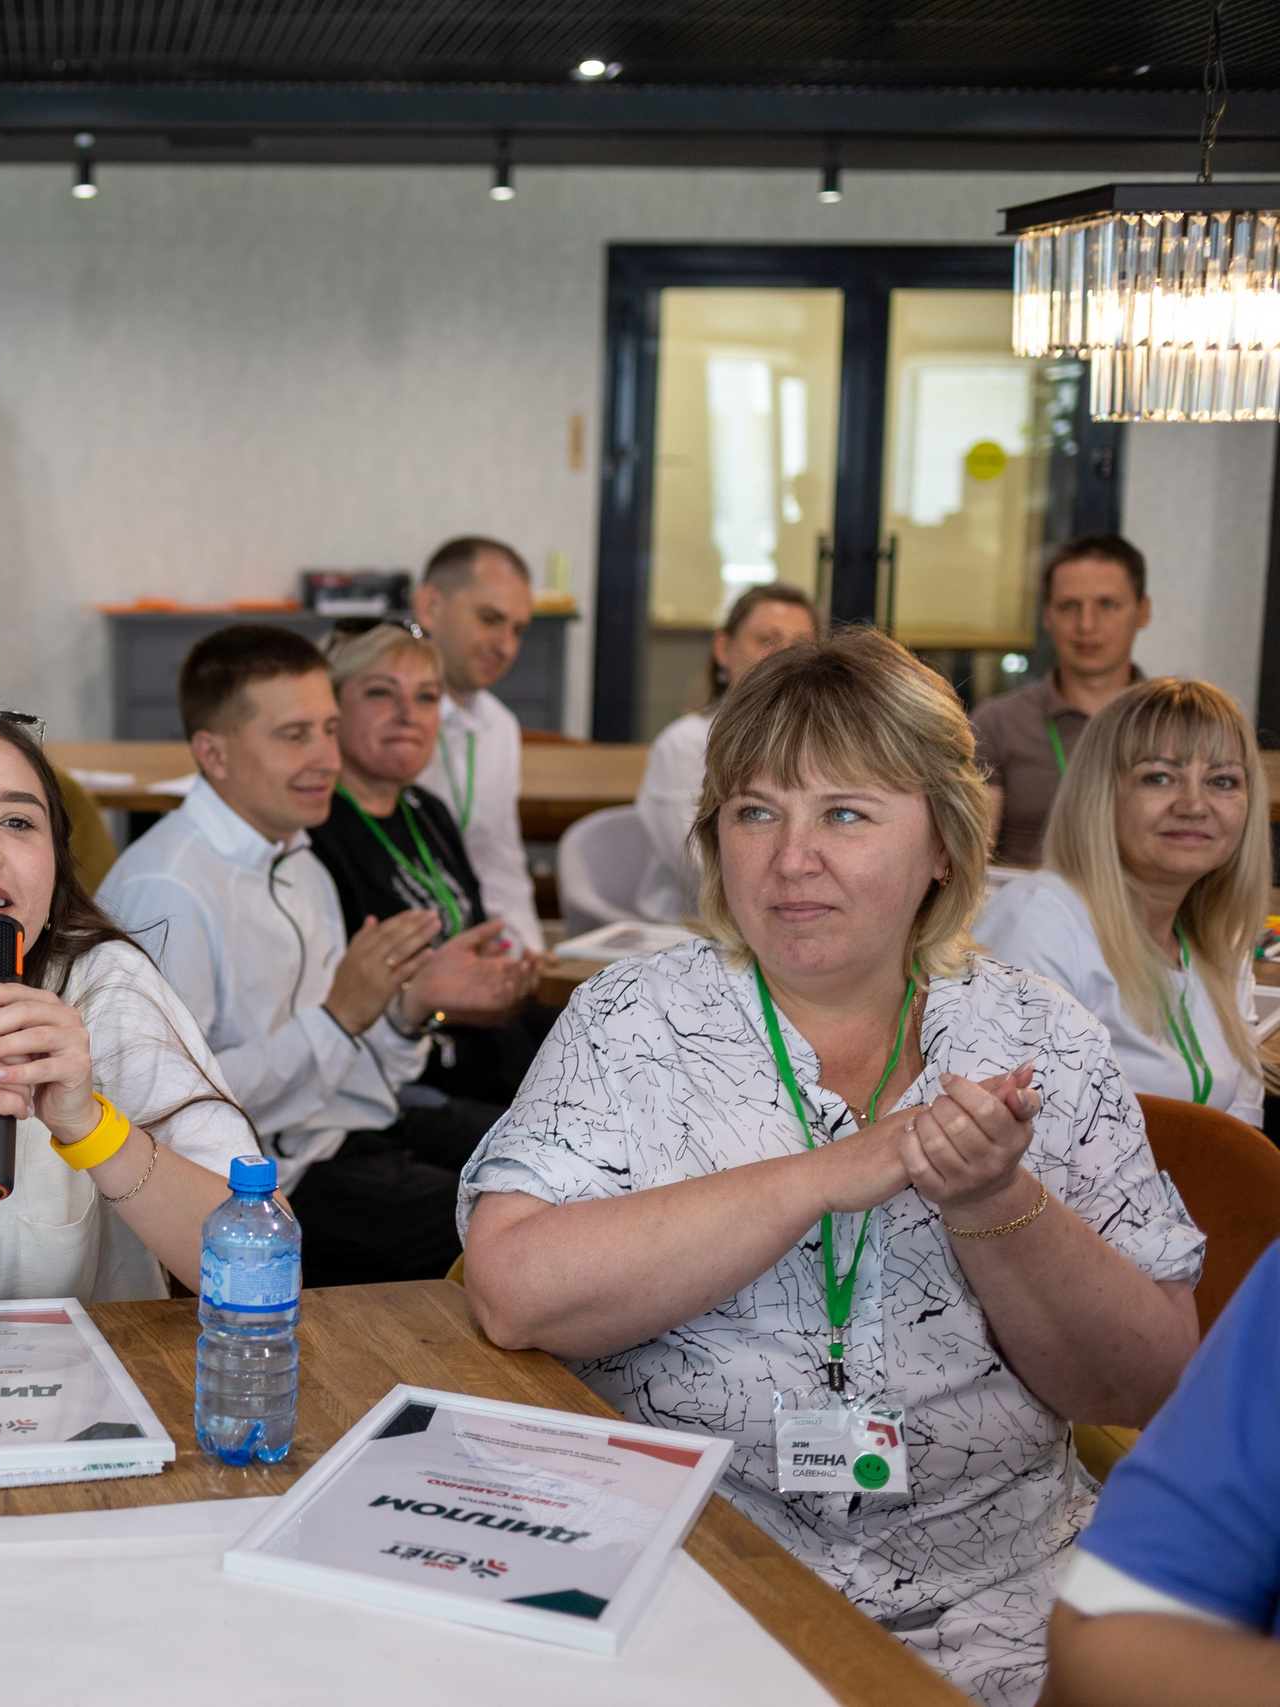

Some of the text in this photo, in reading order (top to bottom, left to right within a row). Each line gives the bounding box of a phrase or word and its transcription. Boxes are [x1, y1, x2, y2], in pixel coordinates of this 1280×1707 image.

[792, 1453, 847, 1466] ЕЛЕНА
[792, 1468, 838, 1478] САВЕНКО
[426, 1478, 511, 1497] САВЕНКО
[369, 1494, 592, 1544] ДИПЛОМ
[380, 1545, 468, 1565] СЛЁТ
